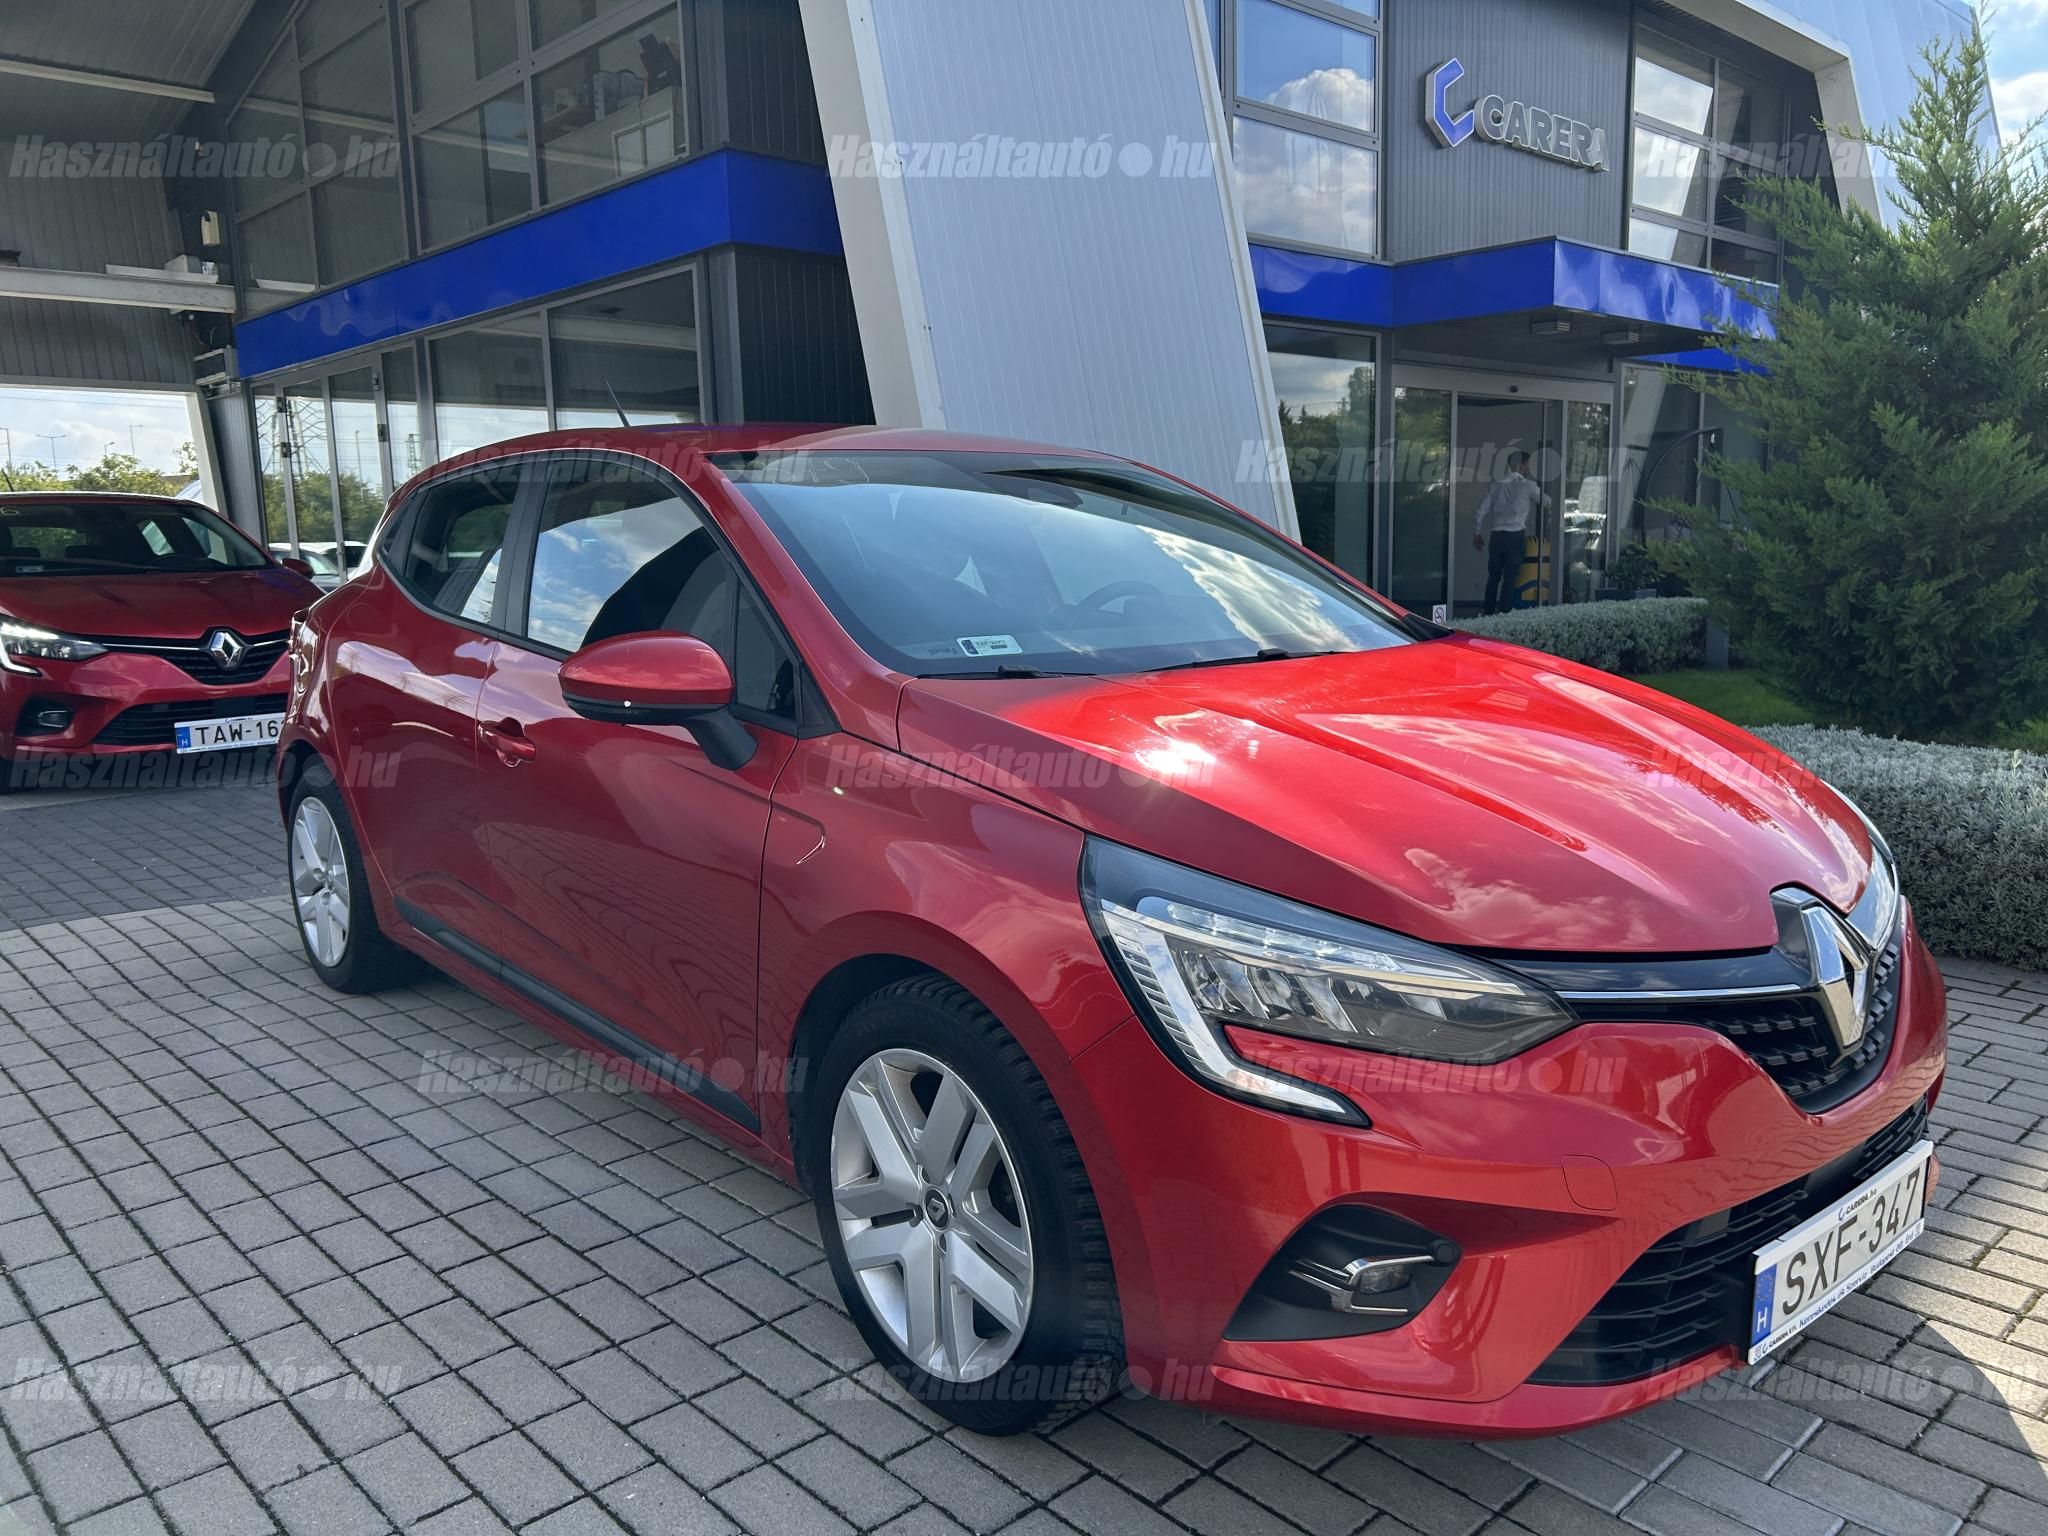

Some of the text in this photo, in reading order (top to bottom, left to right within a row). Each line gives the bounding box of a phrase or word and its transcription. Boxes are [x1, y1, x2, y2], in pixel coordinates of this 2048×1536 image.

[1474, 94, 1610, 173] CARERA
[195, 720, 284, 745] TAW-16
[1782, 1167, 1920, 1316] SXF-347
[1756, 1307, 1768, 1333] H
